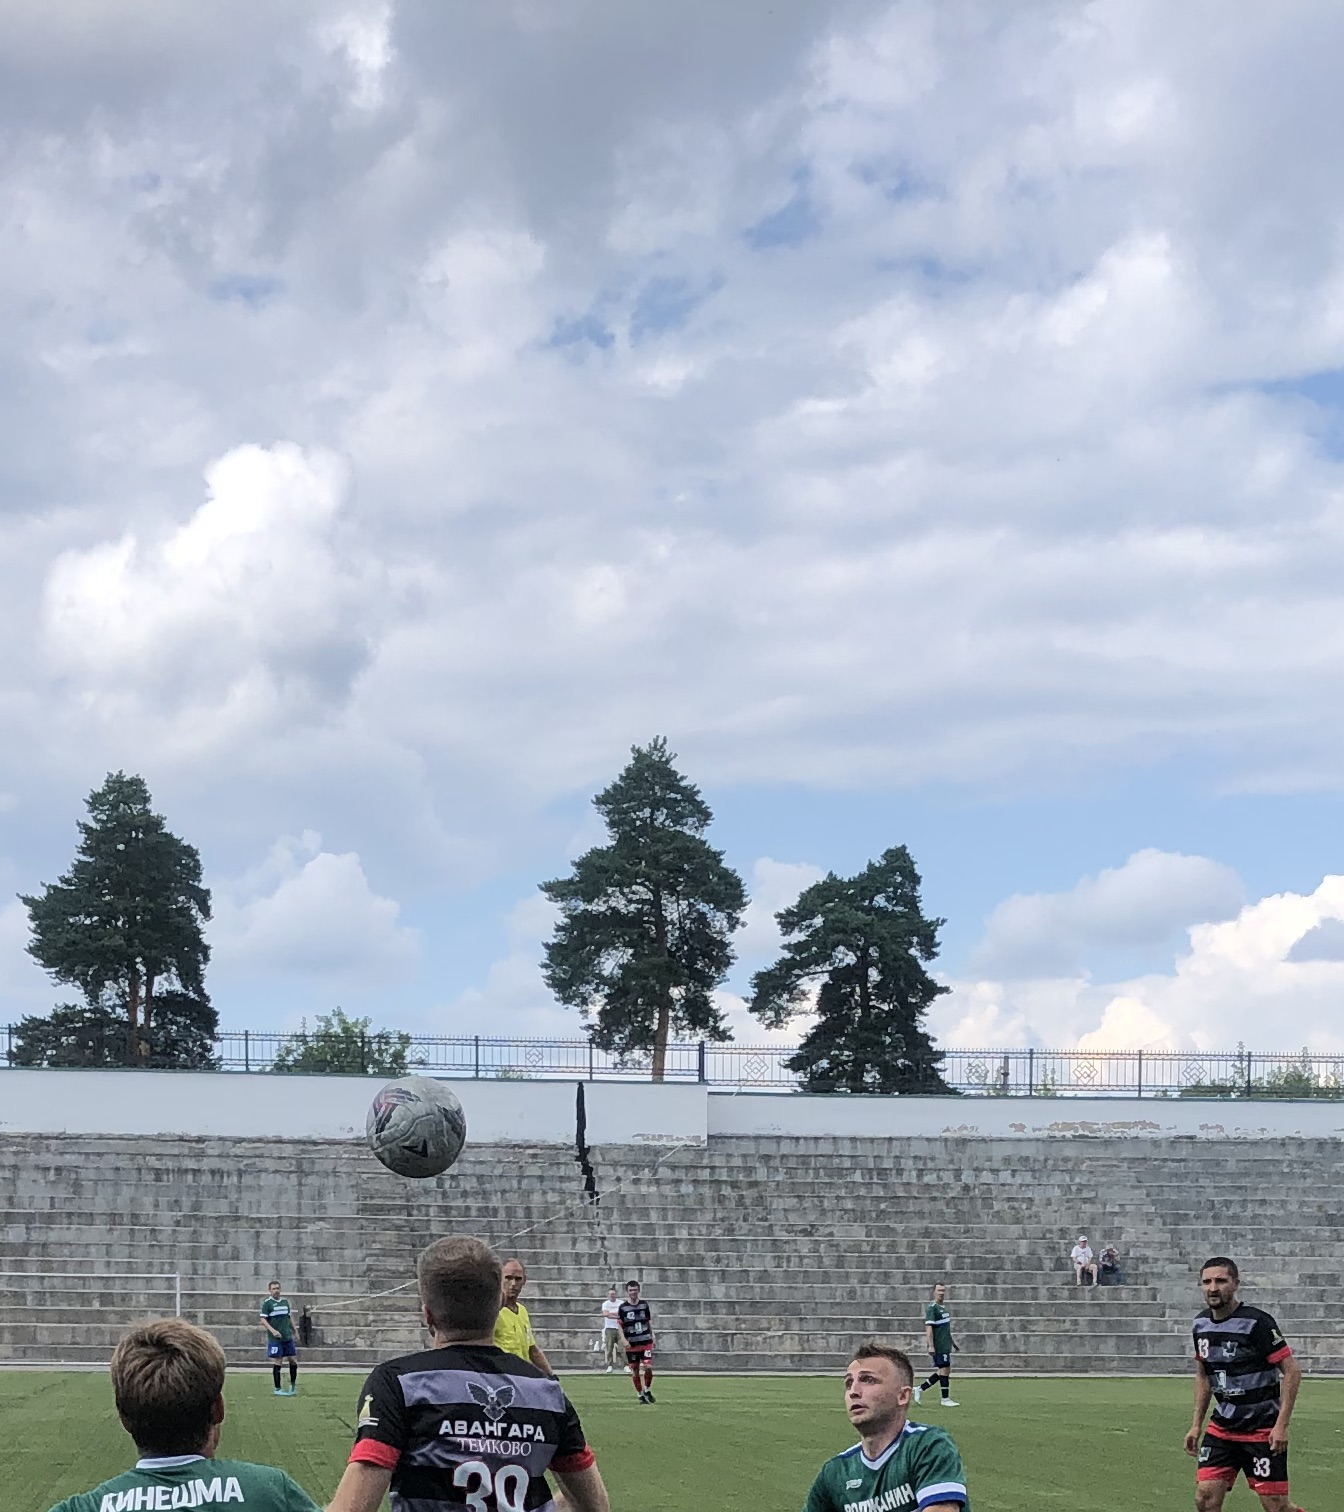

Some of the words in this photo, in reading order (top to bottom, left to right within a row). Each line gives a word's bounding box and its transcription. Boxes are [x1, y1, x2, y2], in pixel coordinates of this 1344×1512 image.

[439, 1420, 545, 1443] АВАНГАРД
[456, 1436, 532, 1457] ТЕЙКОВО
[1252, 1457, 1271, 1478] 33
